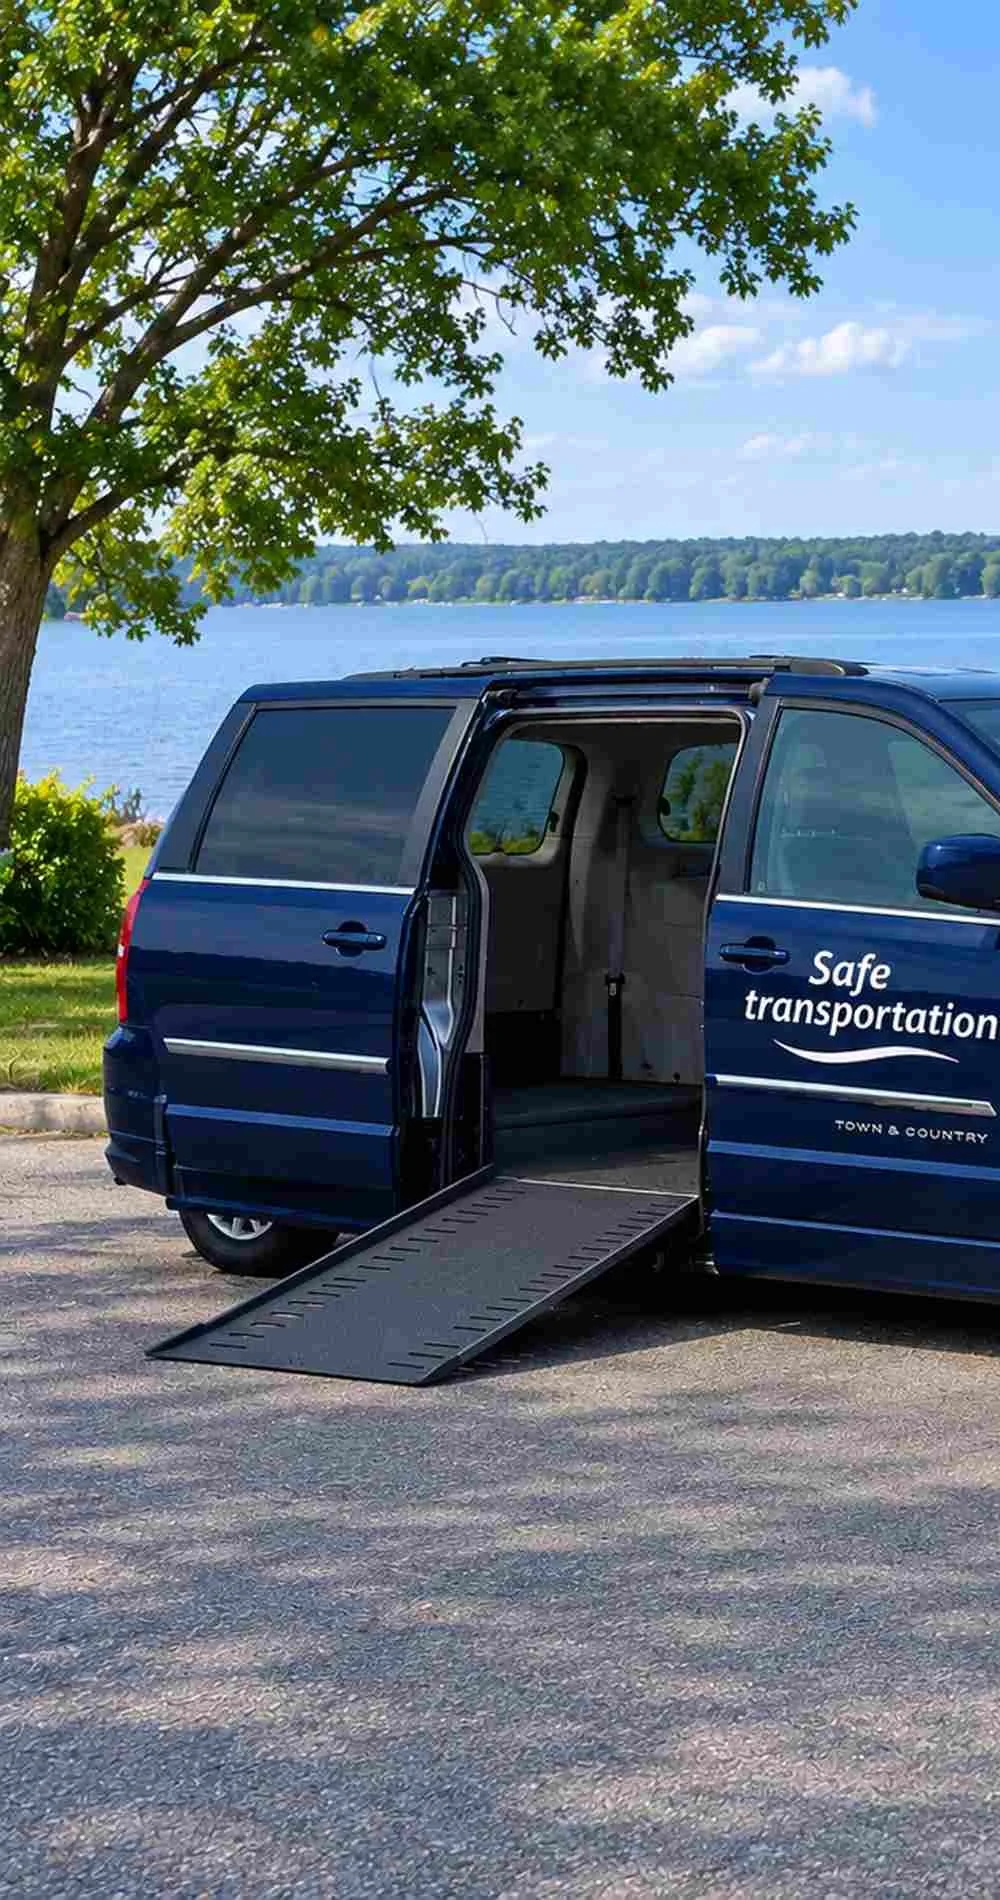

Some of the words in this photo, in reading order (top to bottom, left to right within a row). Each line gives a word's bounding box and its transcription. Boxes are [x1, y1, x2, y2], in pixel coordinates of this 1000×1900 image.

[808, 950, 891, 997] Safe
[744, 990, 998, 1040] transportation
[834, 1119, 883, 1135] TOWN
[887, 1125, 900, 1136] &
[905, 1126, 989, 1144] COUNTRY
